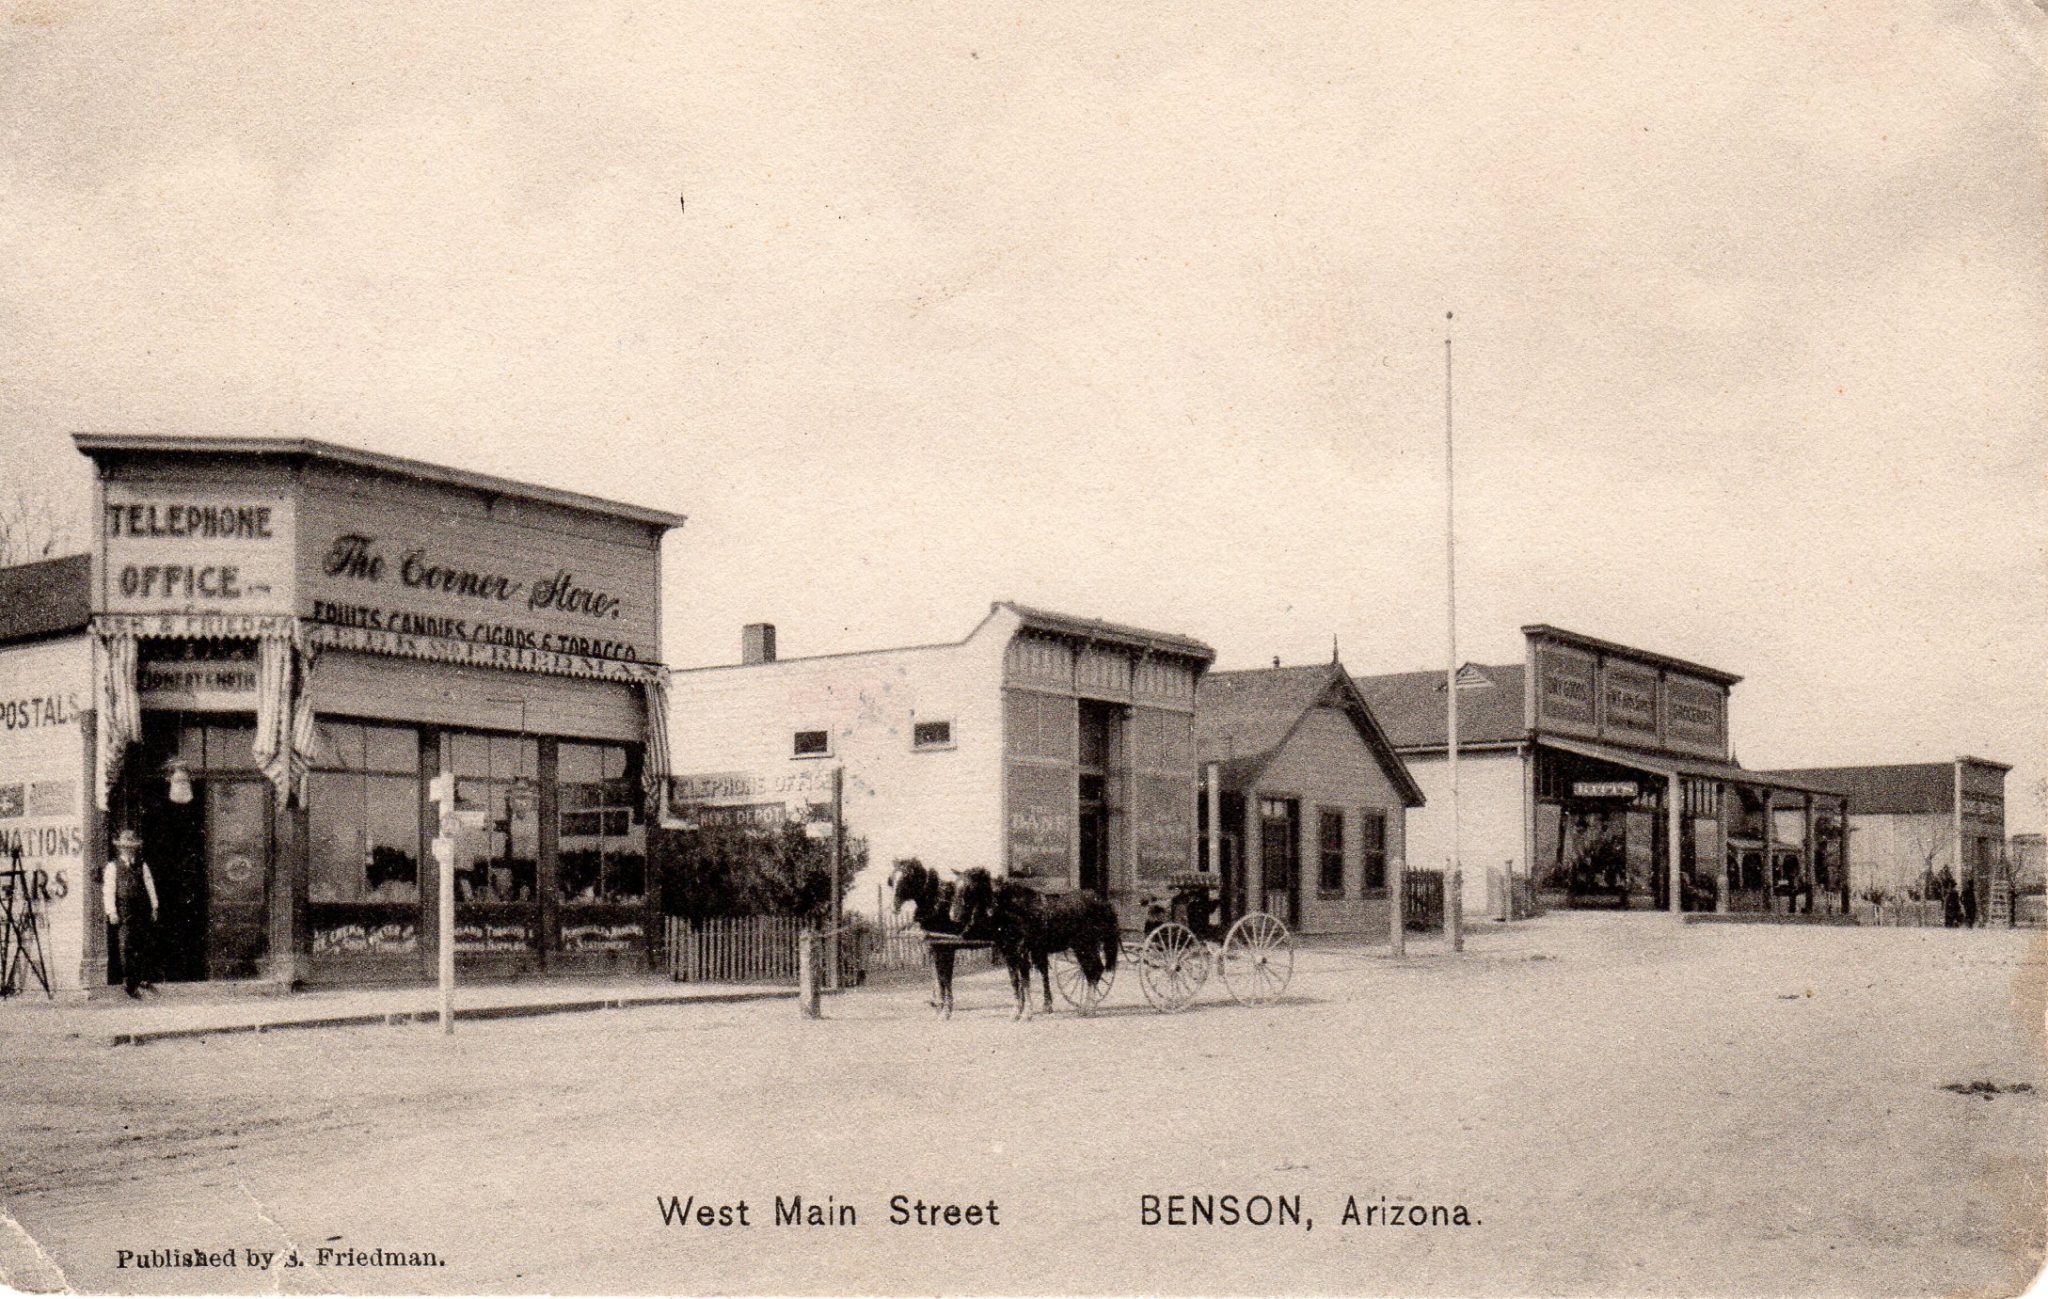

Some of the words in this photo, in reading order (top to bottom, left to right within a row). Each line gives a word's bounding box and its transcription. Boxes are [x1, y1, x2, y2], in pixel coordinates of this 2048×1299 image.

[107, 504, 273, 538] TELEPHONE
[119, 565, 241, 599] OFFICE
[322, 532, 386, 583] The
[401, 549, 523, 602] Corner
